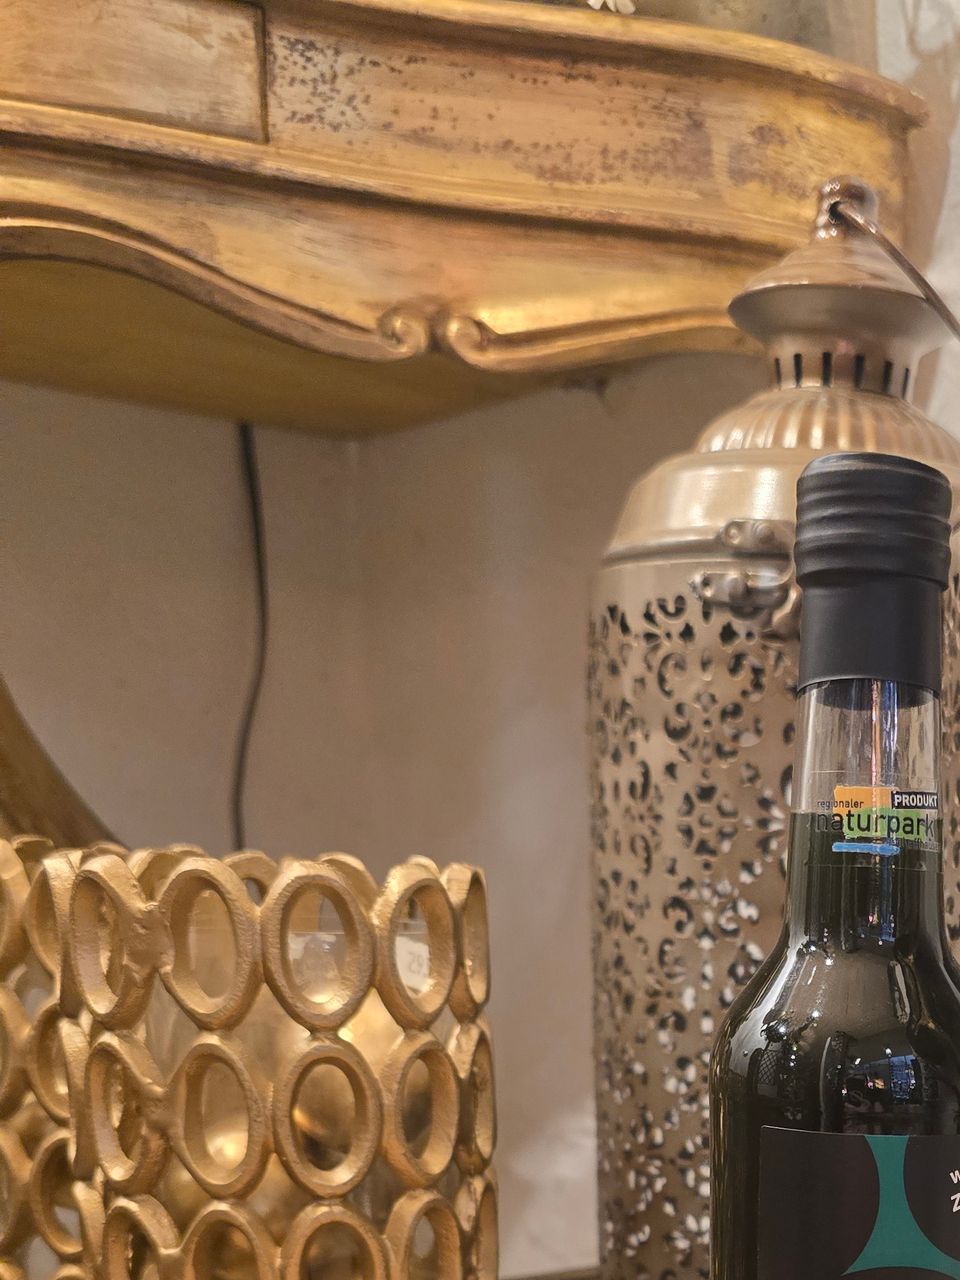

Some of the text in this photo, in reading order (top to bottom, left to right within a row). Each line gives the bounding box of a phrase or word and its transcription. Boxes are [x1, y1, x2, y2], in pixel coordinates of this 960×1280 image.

[817, 798, 865, 811] regionaler
[894, 794, 938, 807] PRODUKT
[816, 809, 936, 840] naturpark
